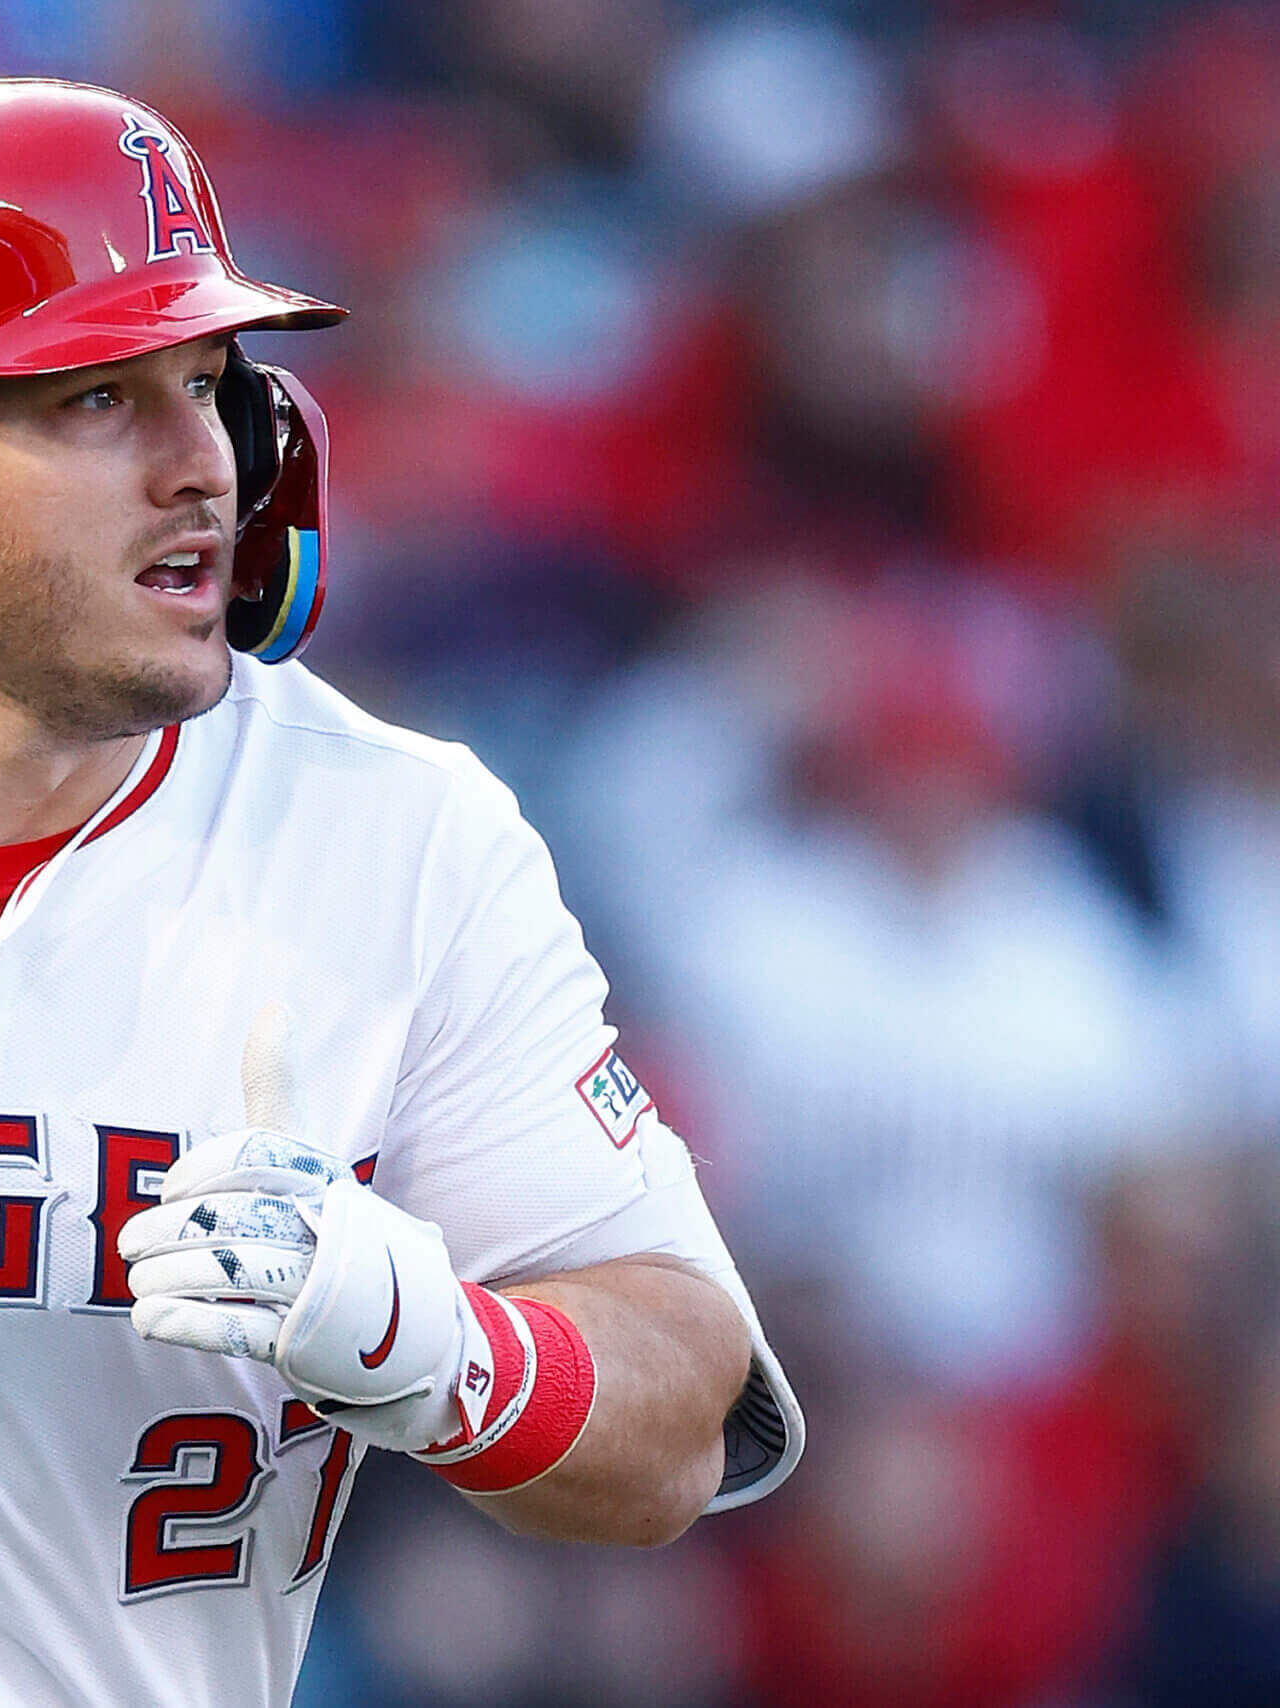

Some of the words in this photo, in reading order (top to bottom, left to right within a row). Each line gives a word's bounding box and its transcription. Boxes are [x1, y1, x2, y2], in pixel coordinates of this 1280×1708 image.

[120, 113, 217, 264] A
[465, 1360, 491, 1397] 27
[120, 1399, 354, 1600] 27
